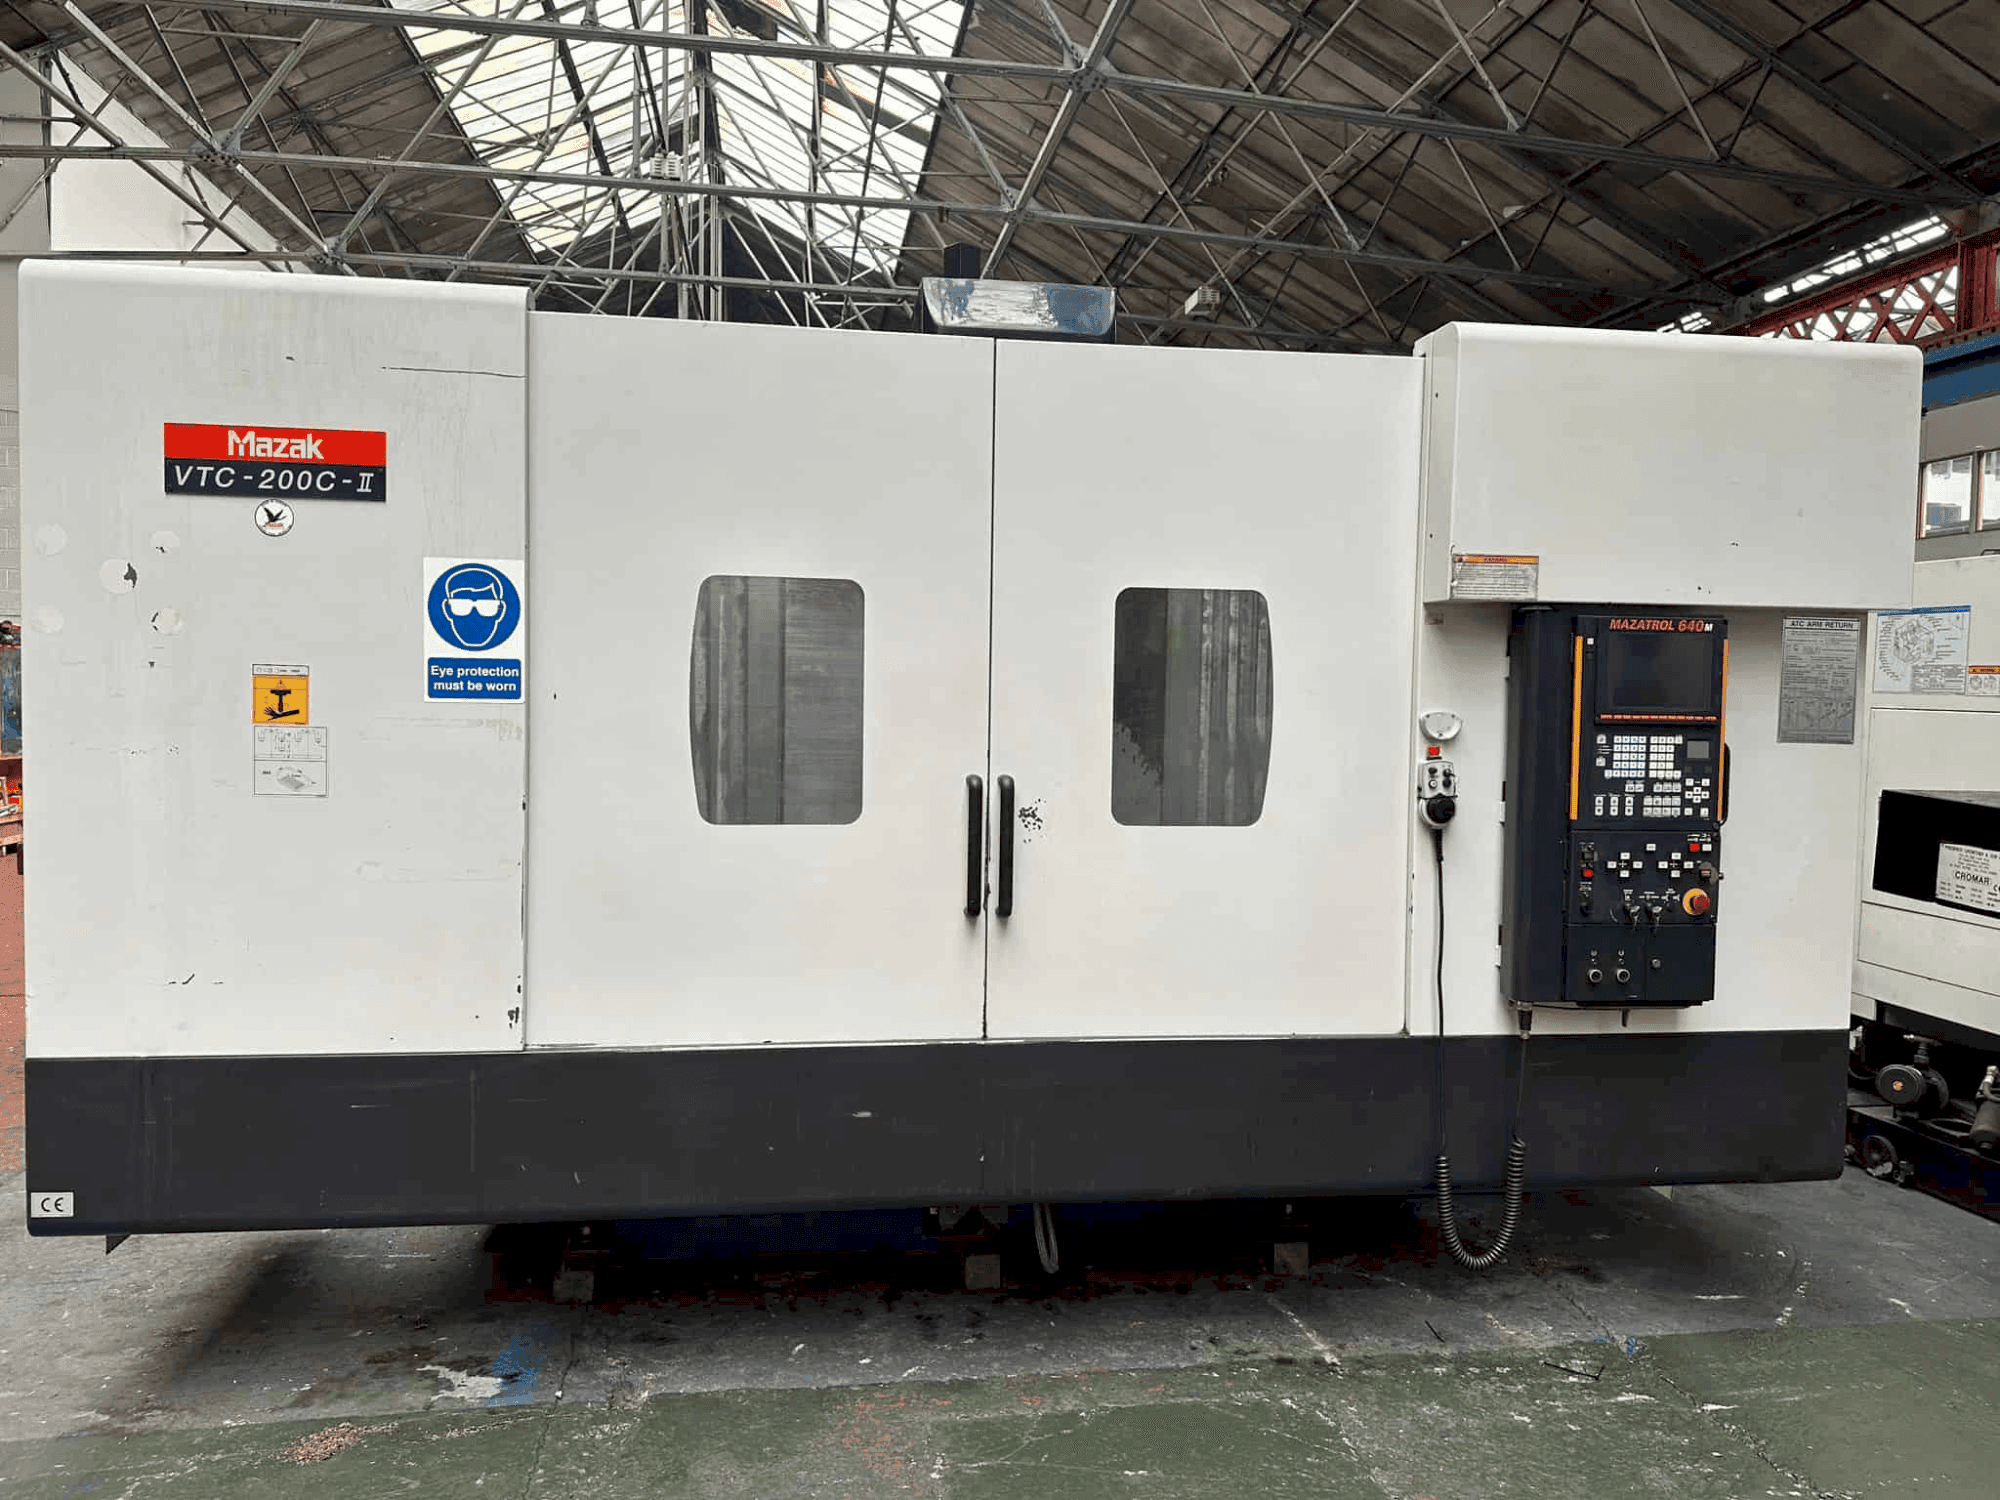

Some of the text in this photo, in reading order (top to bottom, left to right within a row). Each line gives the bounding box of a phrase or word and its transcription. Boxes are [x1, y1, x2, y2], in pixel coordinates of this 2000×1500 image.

[227, 429, 325, 460] Mazak
[1609, 618, 1675, 631] MAZATROL
[430, 665, 520, 678] Eye protection
[433, 680, 517, 691] must be worn
[41, 1197, 64, 1212] CE
